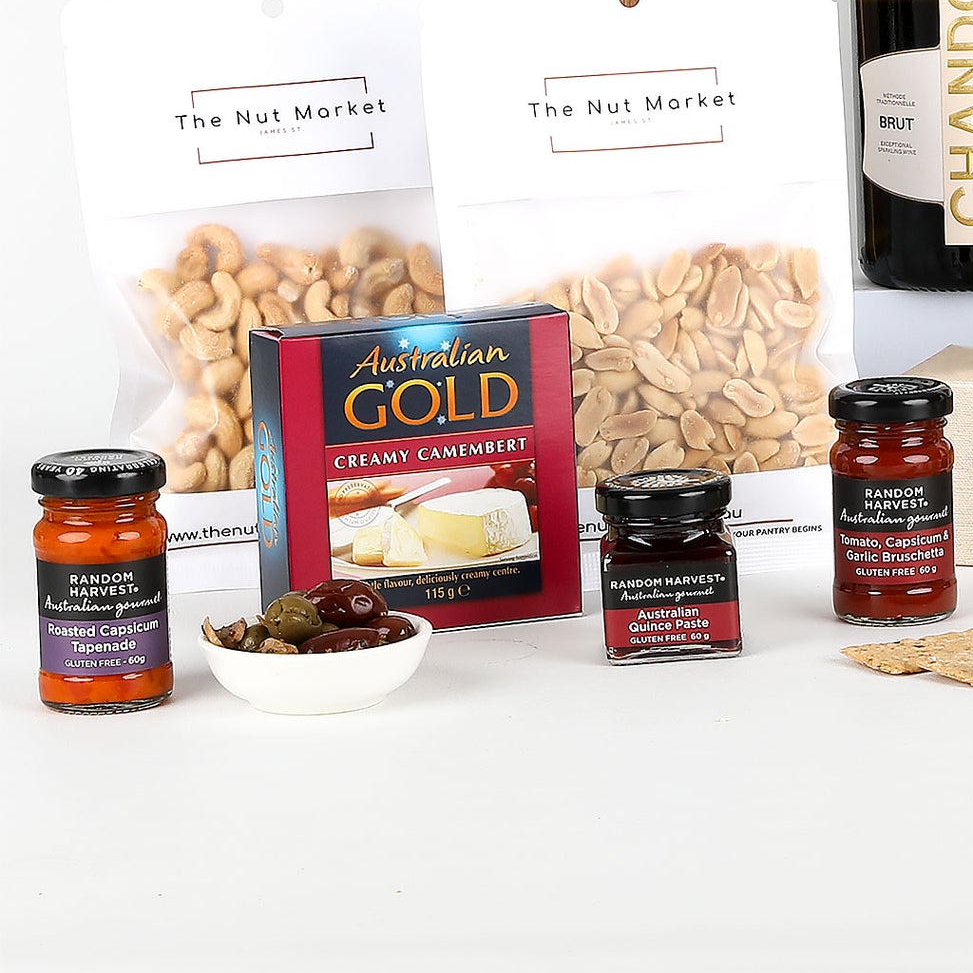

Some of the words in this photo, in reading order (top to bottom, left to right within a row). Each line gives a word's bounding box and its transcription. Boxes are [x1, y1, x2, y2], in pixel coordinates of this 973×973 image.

[528, 102, 573, 118] The
[587, 98, 631, 115] Nut
[645, 91, 736, 112] Market
[175, 114, 221, 130] The
[236, 108, 281, 125] Nut
[294, 99, 387, 121] Market
[879, 115, 915, 131] BRUT
[349, 336, 510, 379] Australian
[344, 372, 519, 430] GOLD
[333, 448, 410, 470] CREAMY
[417, 437, 528, 461] CAMEMBERT
[65, 465, 86, 477] 40
[864, 486, 924, 499] RANDOM
[839, 507, 906, 524] Australian
[906, 505, 949, 531] gourmet
[755, 526, 791, 537] PANTRY
[791, 524, 823, 533] BEGINS
[839, 533, 882, 550] Tomato,
[885, 533, 942, 549] Capsicum
[943, 529, 949, 540] &
[846, 549, 879, 562] Garlic
[882, 547, 944, 563] Bruschetta
[69, 571, 134, 585] RANDOM
[383, 578, 415, 589] flavour,
[416, 572, 459, 586] deliciously
[460, 571, 490, 581] creamy
[492, 566, 521, 577] centre.
[855, 567, 890, 577] GLUTEN
[891, 567, 916, 576] FREE
[919, 566, 931, 575] 60
[931, 565, 937, 574] g
[610, 577, 662, 590] RANDOM
[425, 588, 444, 600] 115
[447, 587, 455, 600] g
[620, 588, 675, 602] Australian
[674, 586, 715, 603] gourmet
[44, 594, 114, 613] Australian
[637, 607, 699, 621] Australian
[47, 623, 96, 638] Roasted
[99, 619, 159, 638] Capsicum
[628, 621, 672, 633] Quince
[675, 618, 710, 630] Paste
[70, 638, 137, 655] Tapenade
[629, 634, 665, 645] GLUTEN
[665, 633, 687, 642] FREE
[690, 632, 702, 640] 60
[703, 633, 710, 641] g
[64, 658, 98, 668] GLUTEN
[99, 658, 121, 667] FREE
[128, 655, 146, 665] 60g
